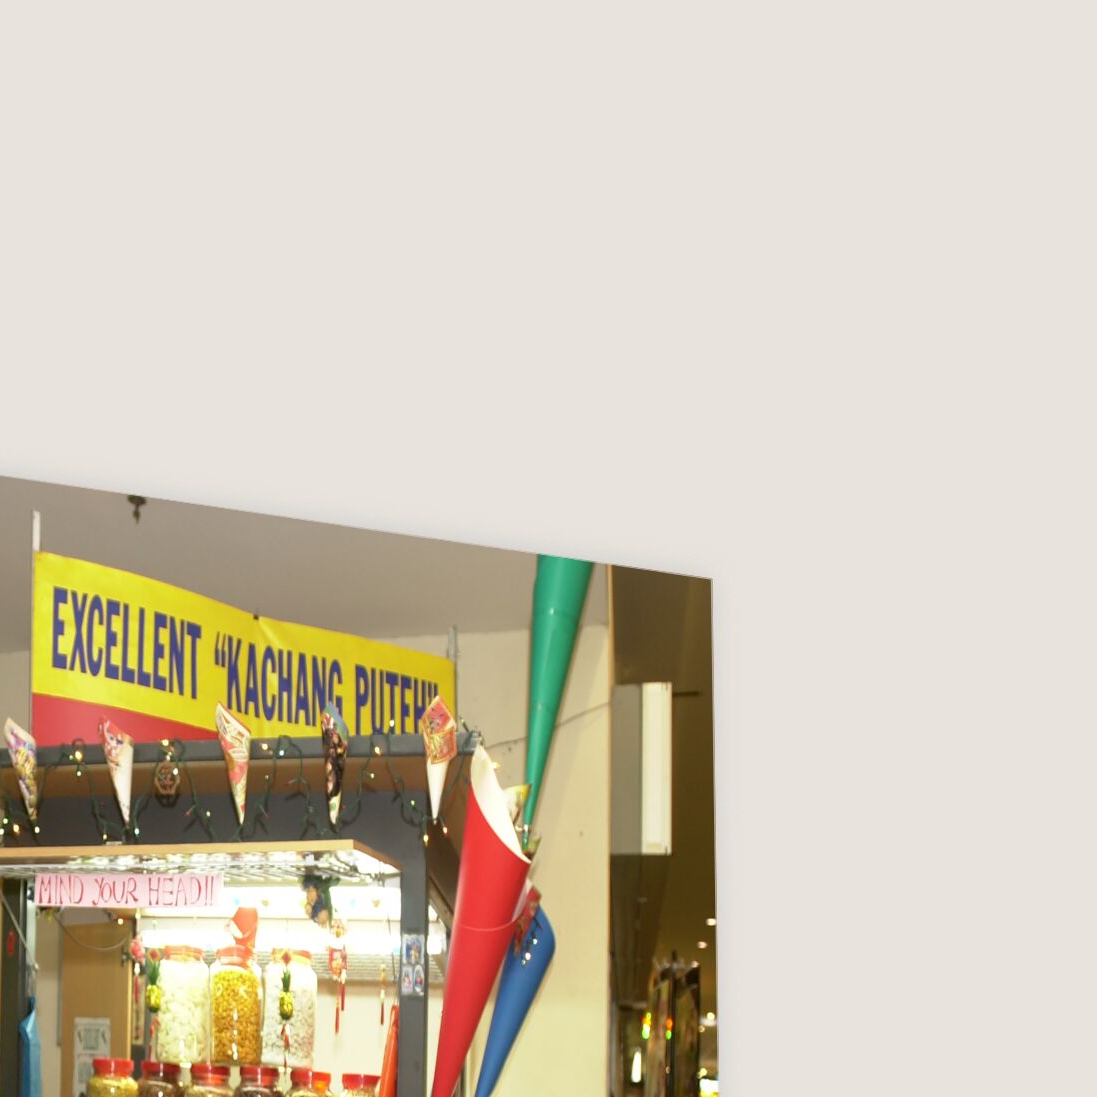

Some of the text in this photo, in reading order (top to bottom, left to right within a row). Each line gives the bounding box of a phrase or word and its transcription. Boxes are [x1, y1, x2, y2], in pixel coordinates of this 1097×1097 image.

[52, 586, 202, 700] EXCELLENT
[38, 875, 85, 905] MIND
[91, 876, 139, 906] YOUR
